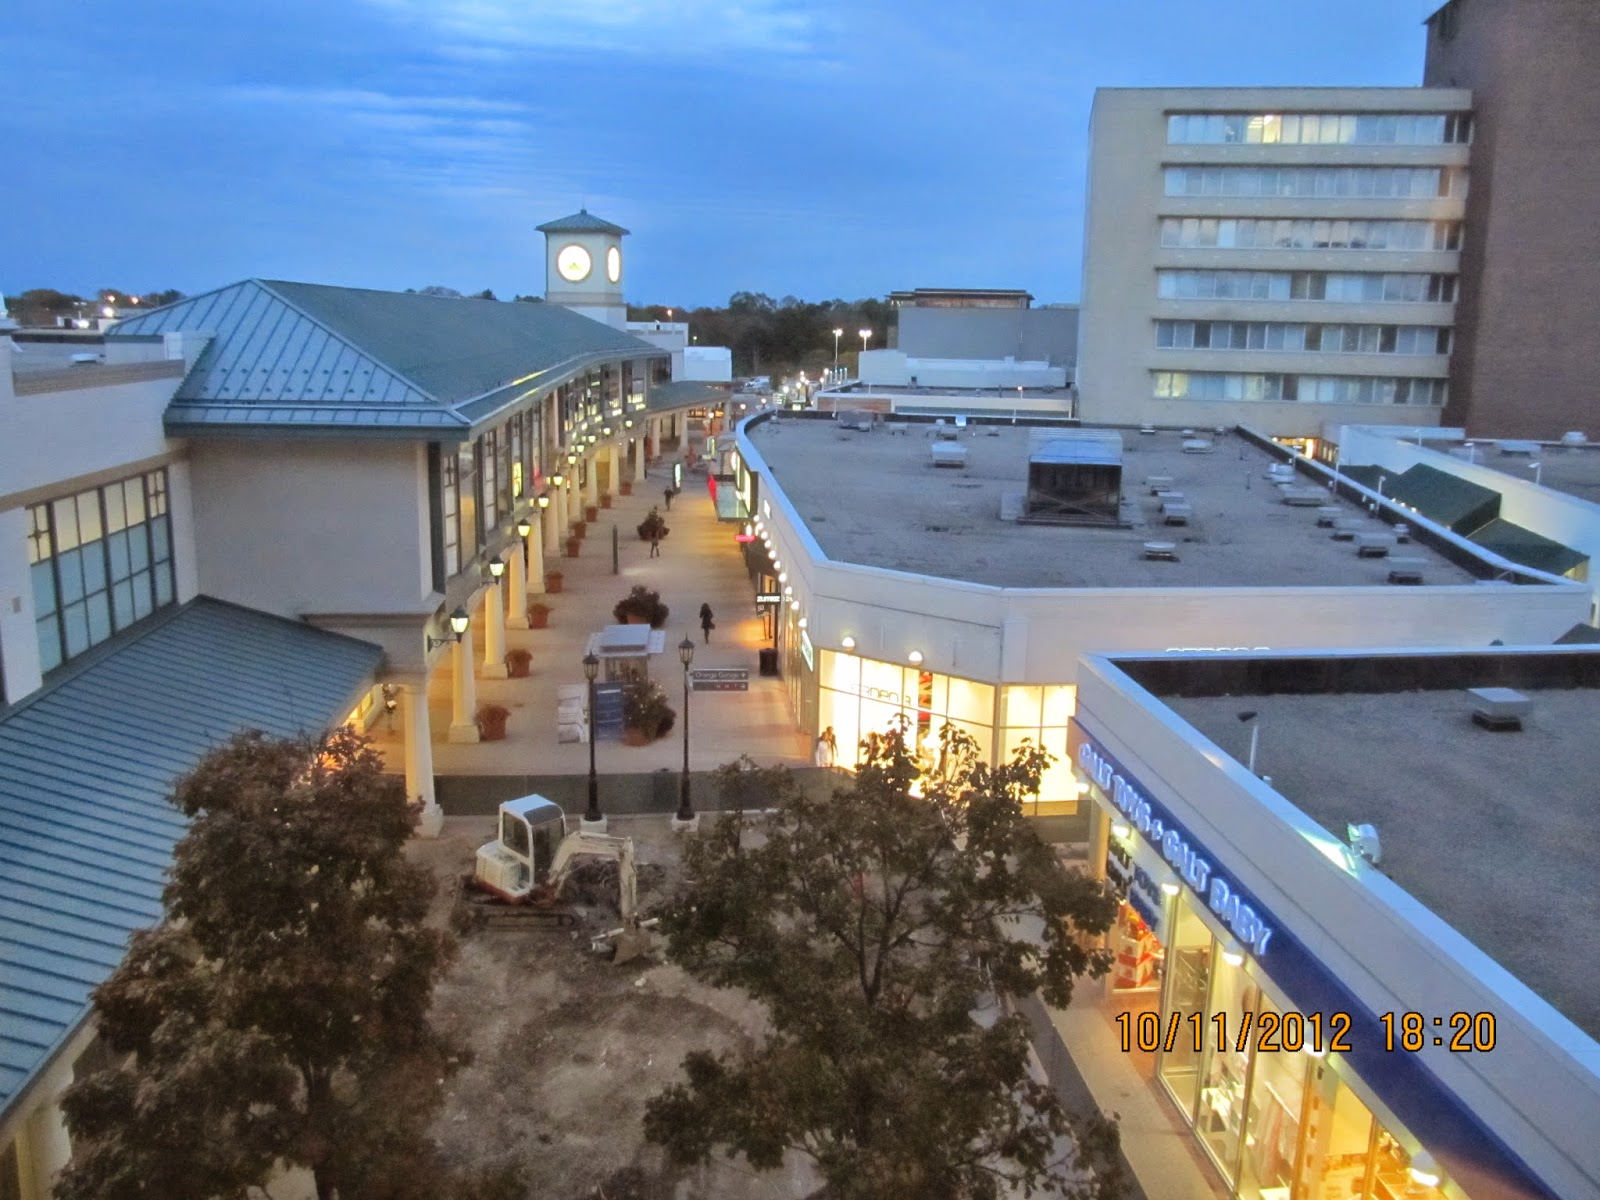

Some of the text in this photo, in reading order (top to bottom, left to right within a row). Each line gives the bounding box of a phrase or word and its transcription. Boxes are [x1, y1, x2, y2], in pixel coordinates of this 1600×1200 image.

[1079, 743, 1113, 790] GALT
[1112, 774, 1151, 832] TOYS
[1162, 830, 1211, 893] GALT
[1209, 878, 1272, 956] BABY
